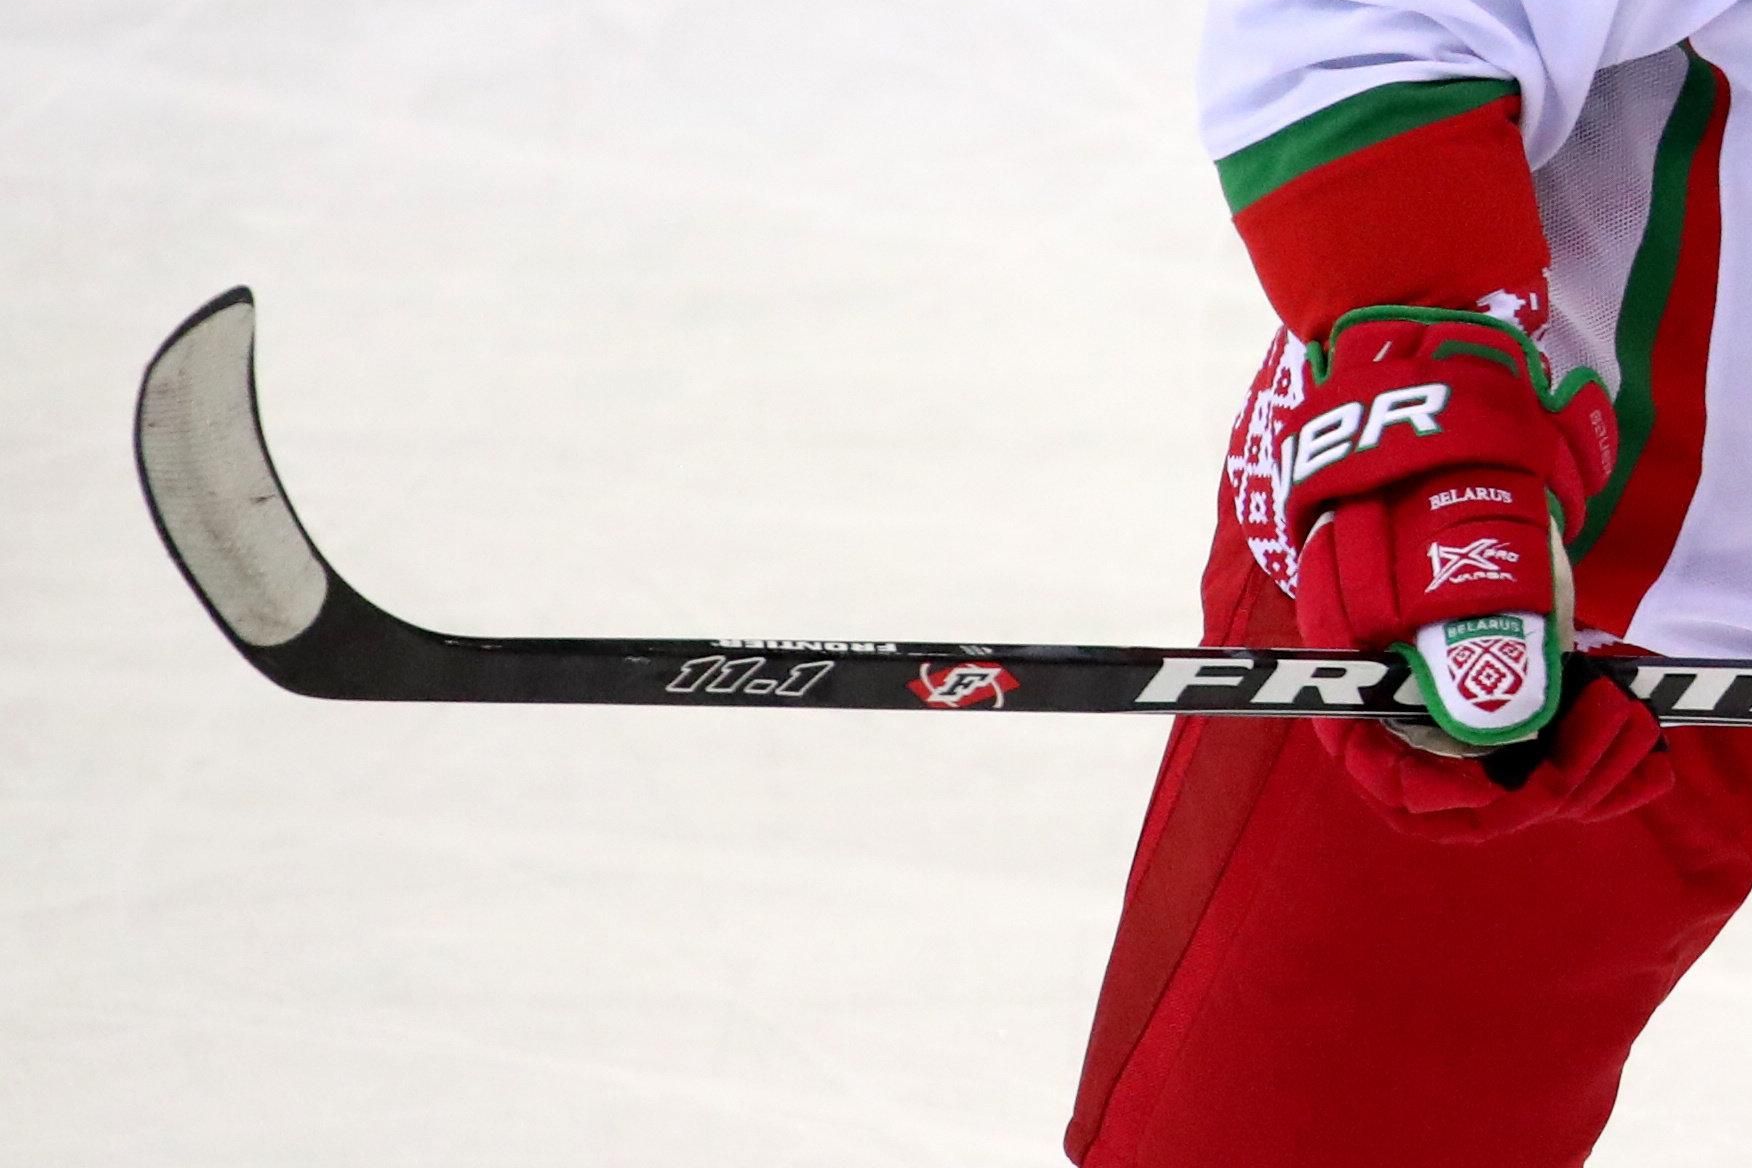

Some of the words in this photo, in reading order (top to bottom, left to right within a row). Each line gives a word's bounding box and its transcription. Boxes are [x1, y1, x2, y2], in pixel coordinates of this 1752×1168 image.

[1429, 487, 1513, 511] BELARUS
[1448, 618, 1521, 638] BELARUS
[666, 655, 835, 696] 11.1
